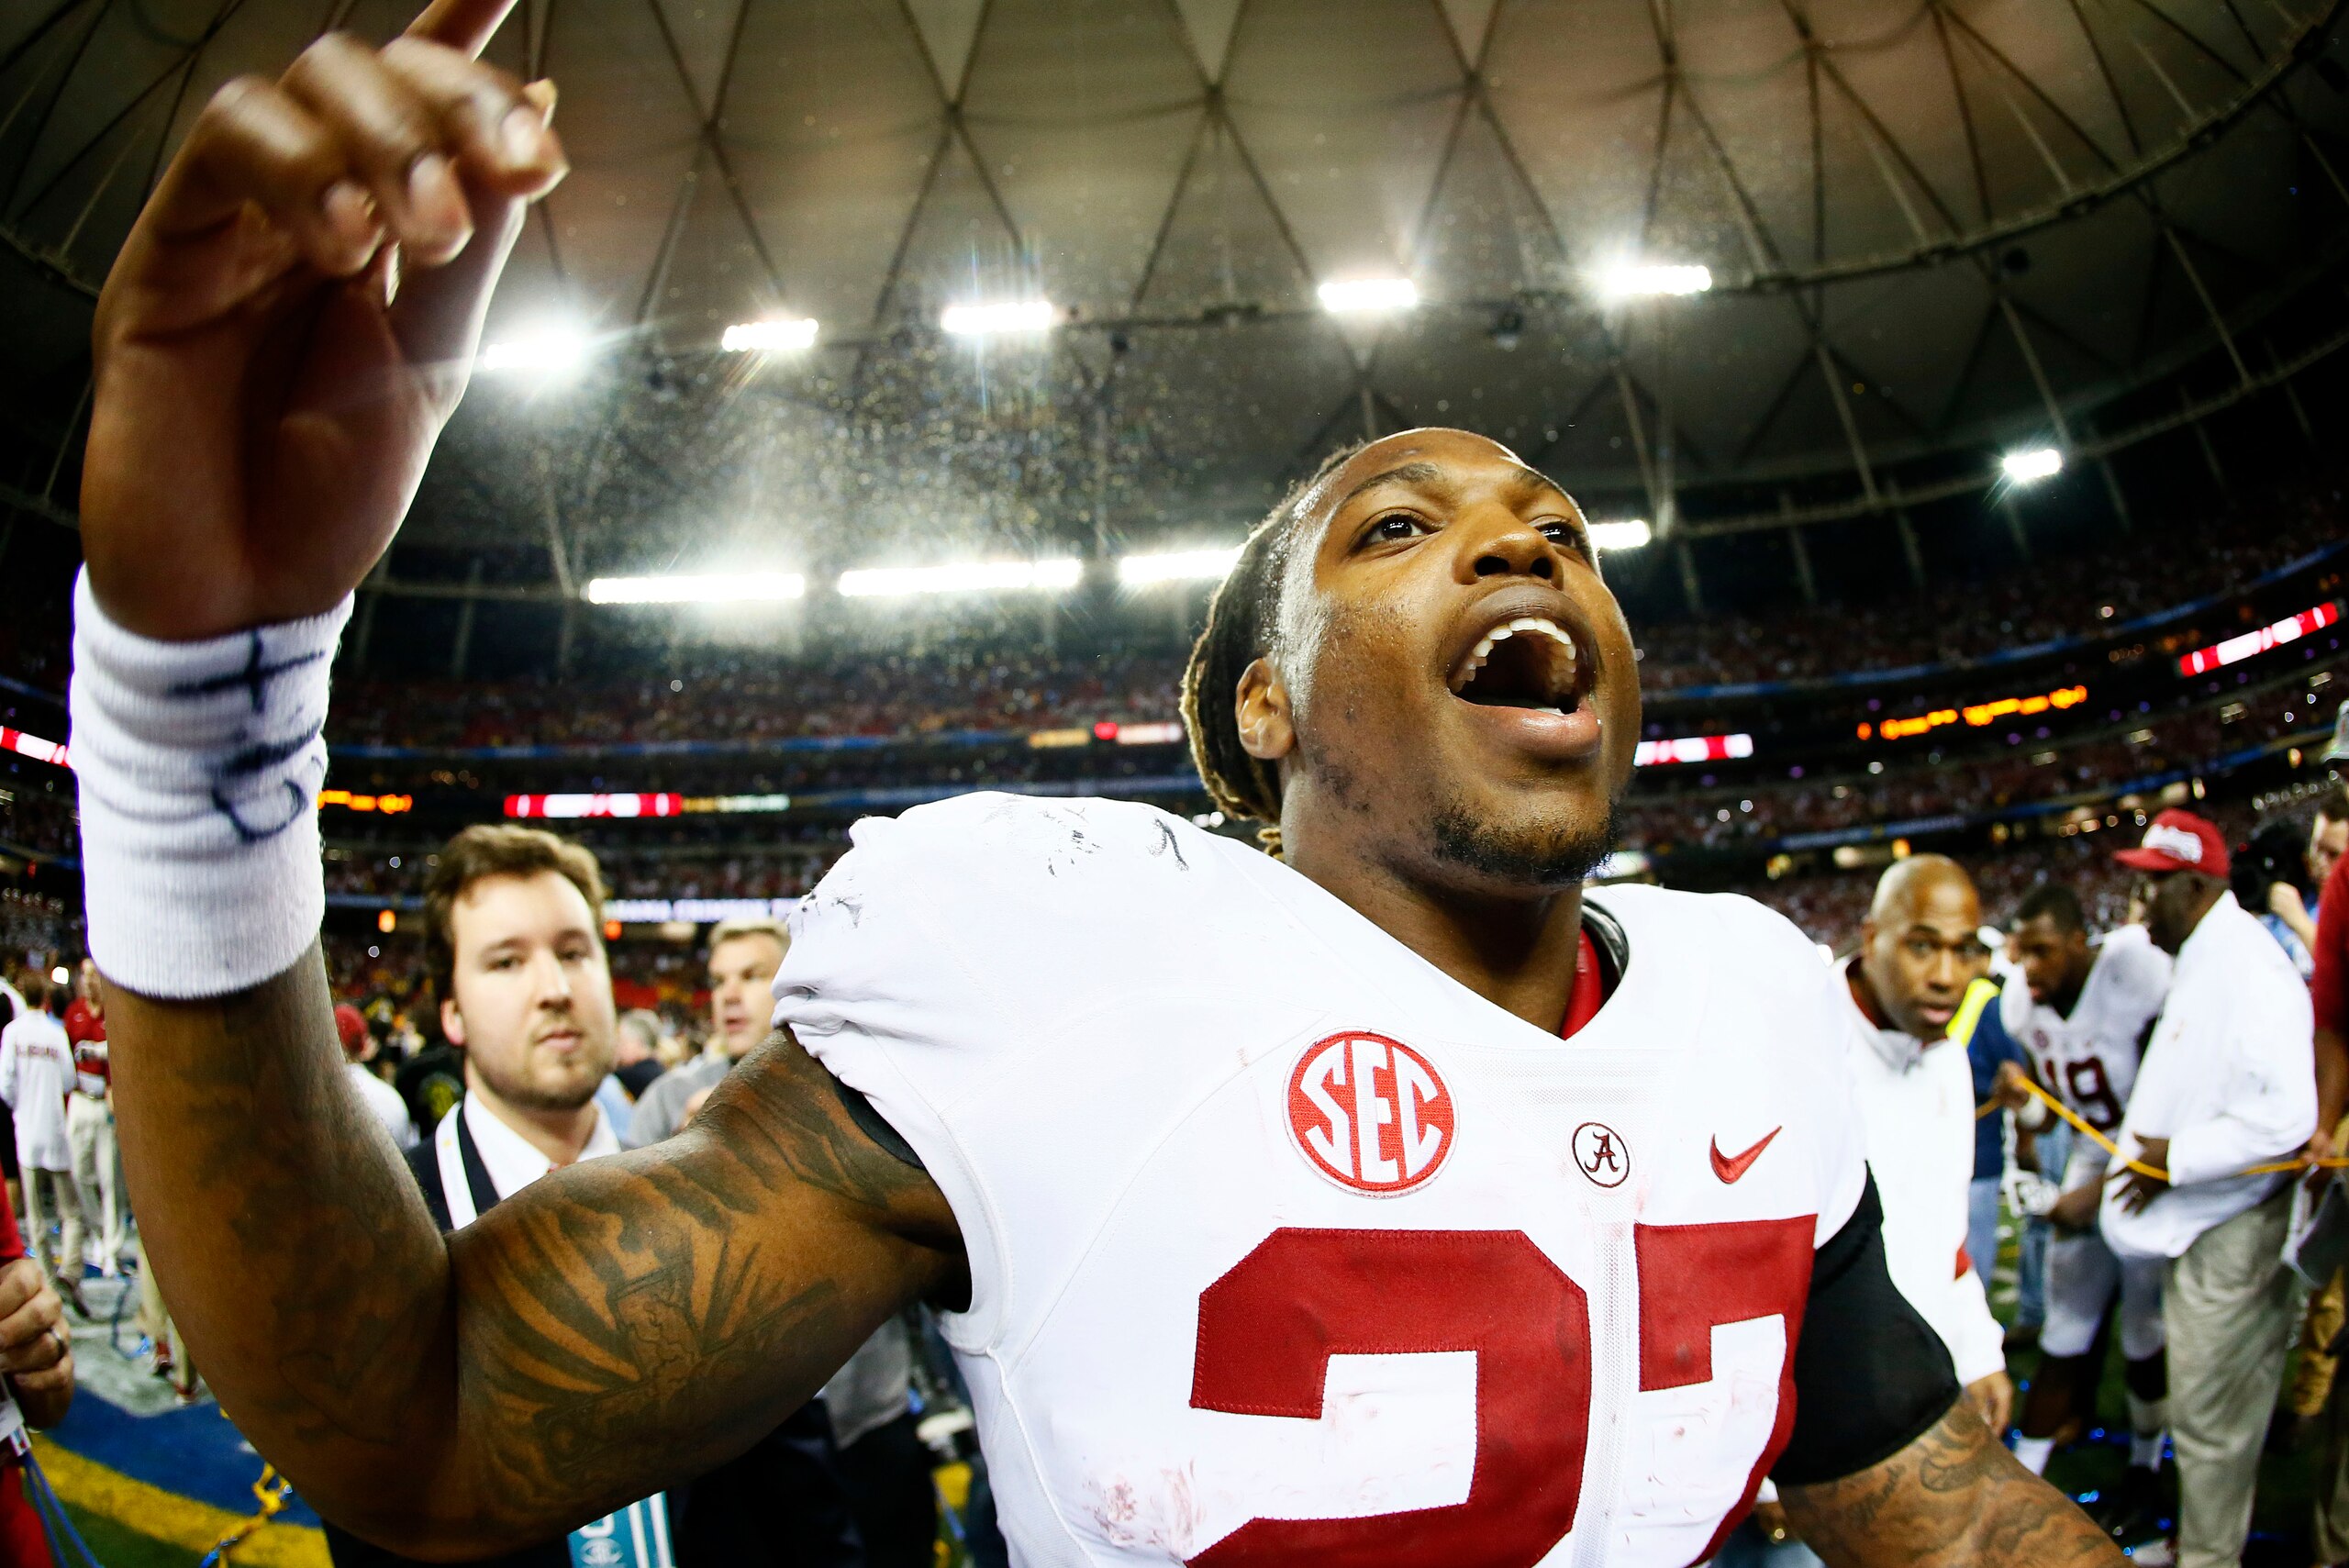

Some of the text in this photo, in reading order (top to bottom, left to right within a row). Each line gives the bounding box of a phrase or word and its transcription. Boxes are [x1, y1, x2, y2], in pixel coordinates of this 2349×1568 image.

[1298, 1038, 1443, 1184] SEC
[1584, 1130, 1620, 1173] A
[1184, 1214, 1818, 1568] 27
